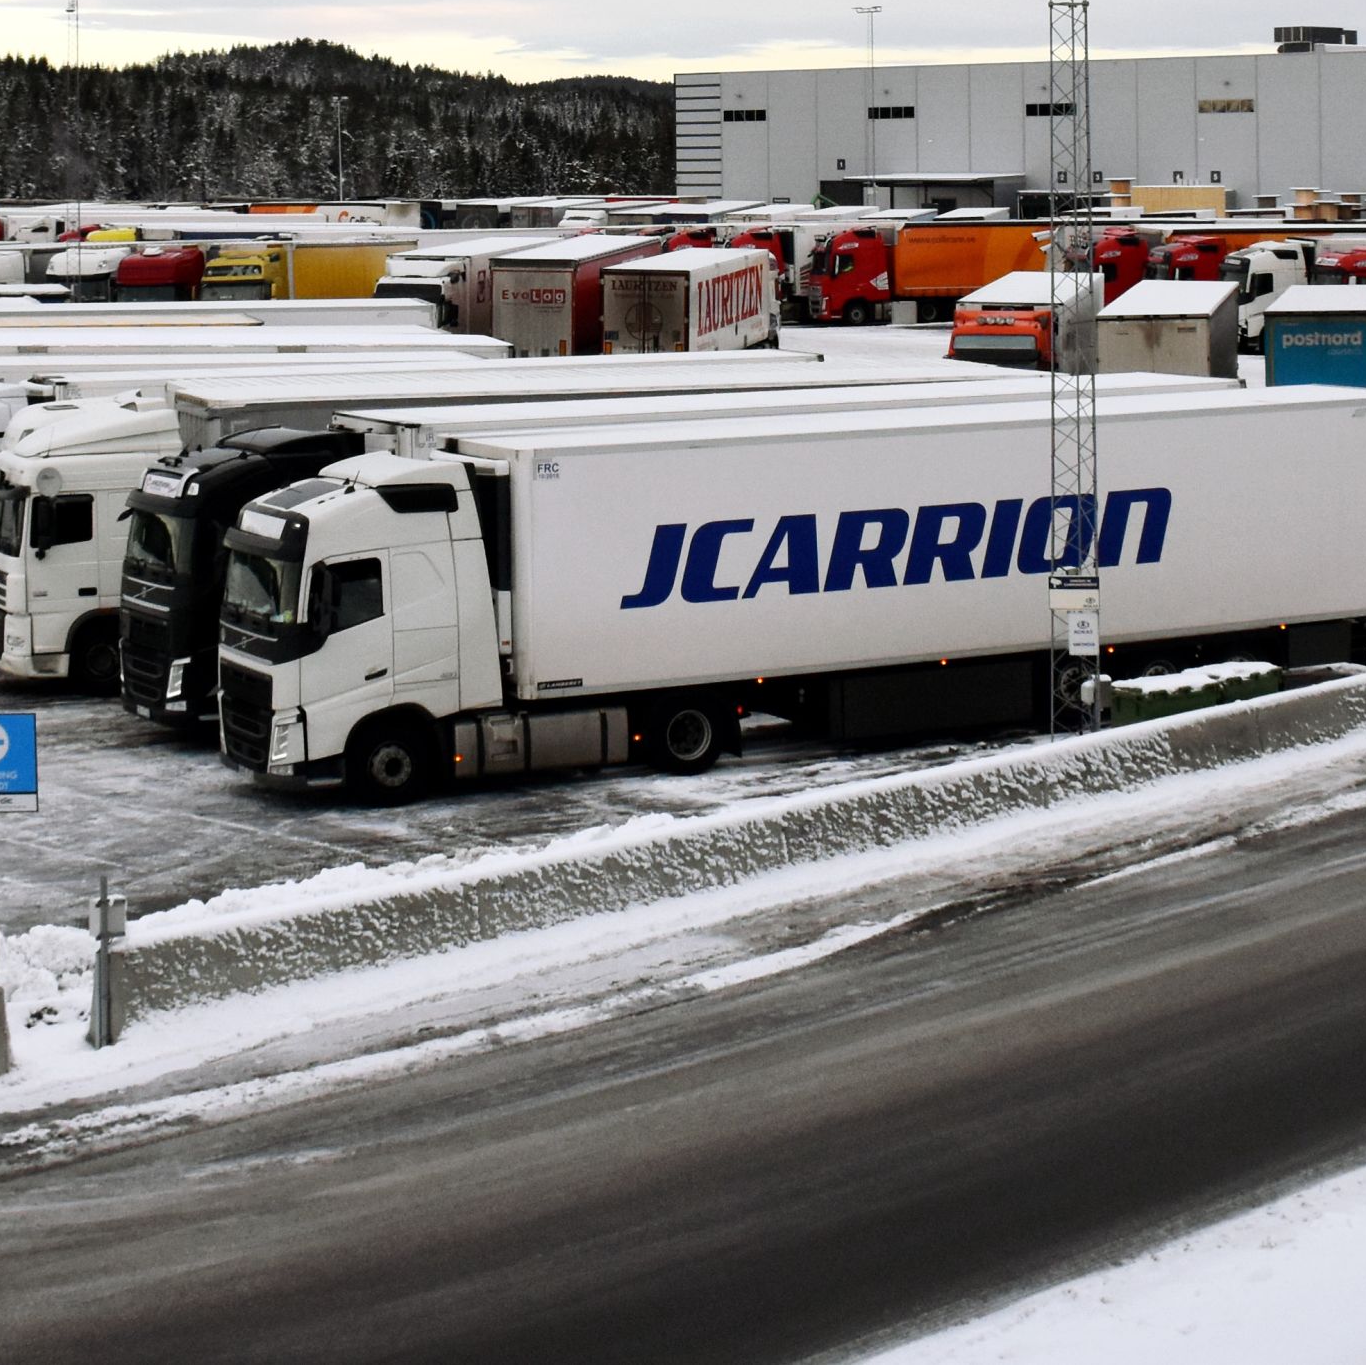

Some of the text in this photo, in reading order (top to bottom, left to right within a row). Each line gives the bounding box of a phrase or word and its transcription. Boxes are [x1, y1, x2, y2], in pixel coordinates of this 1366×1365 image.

[611, 280, 677, 291] LAURITZEN
[502, 289, 565, 303] EvoLog
[697, 264, 764, 336] LAURITZEN
[1282, 331, 1363, 349] postnord
[537, 463, 560, 473] FRC
[620, 487, 1172, 610] JCARRION
